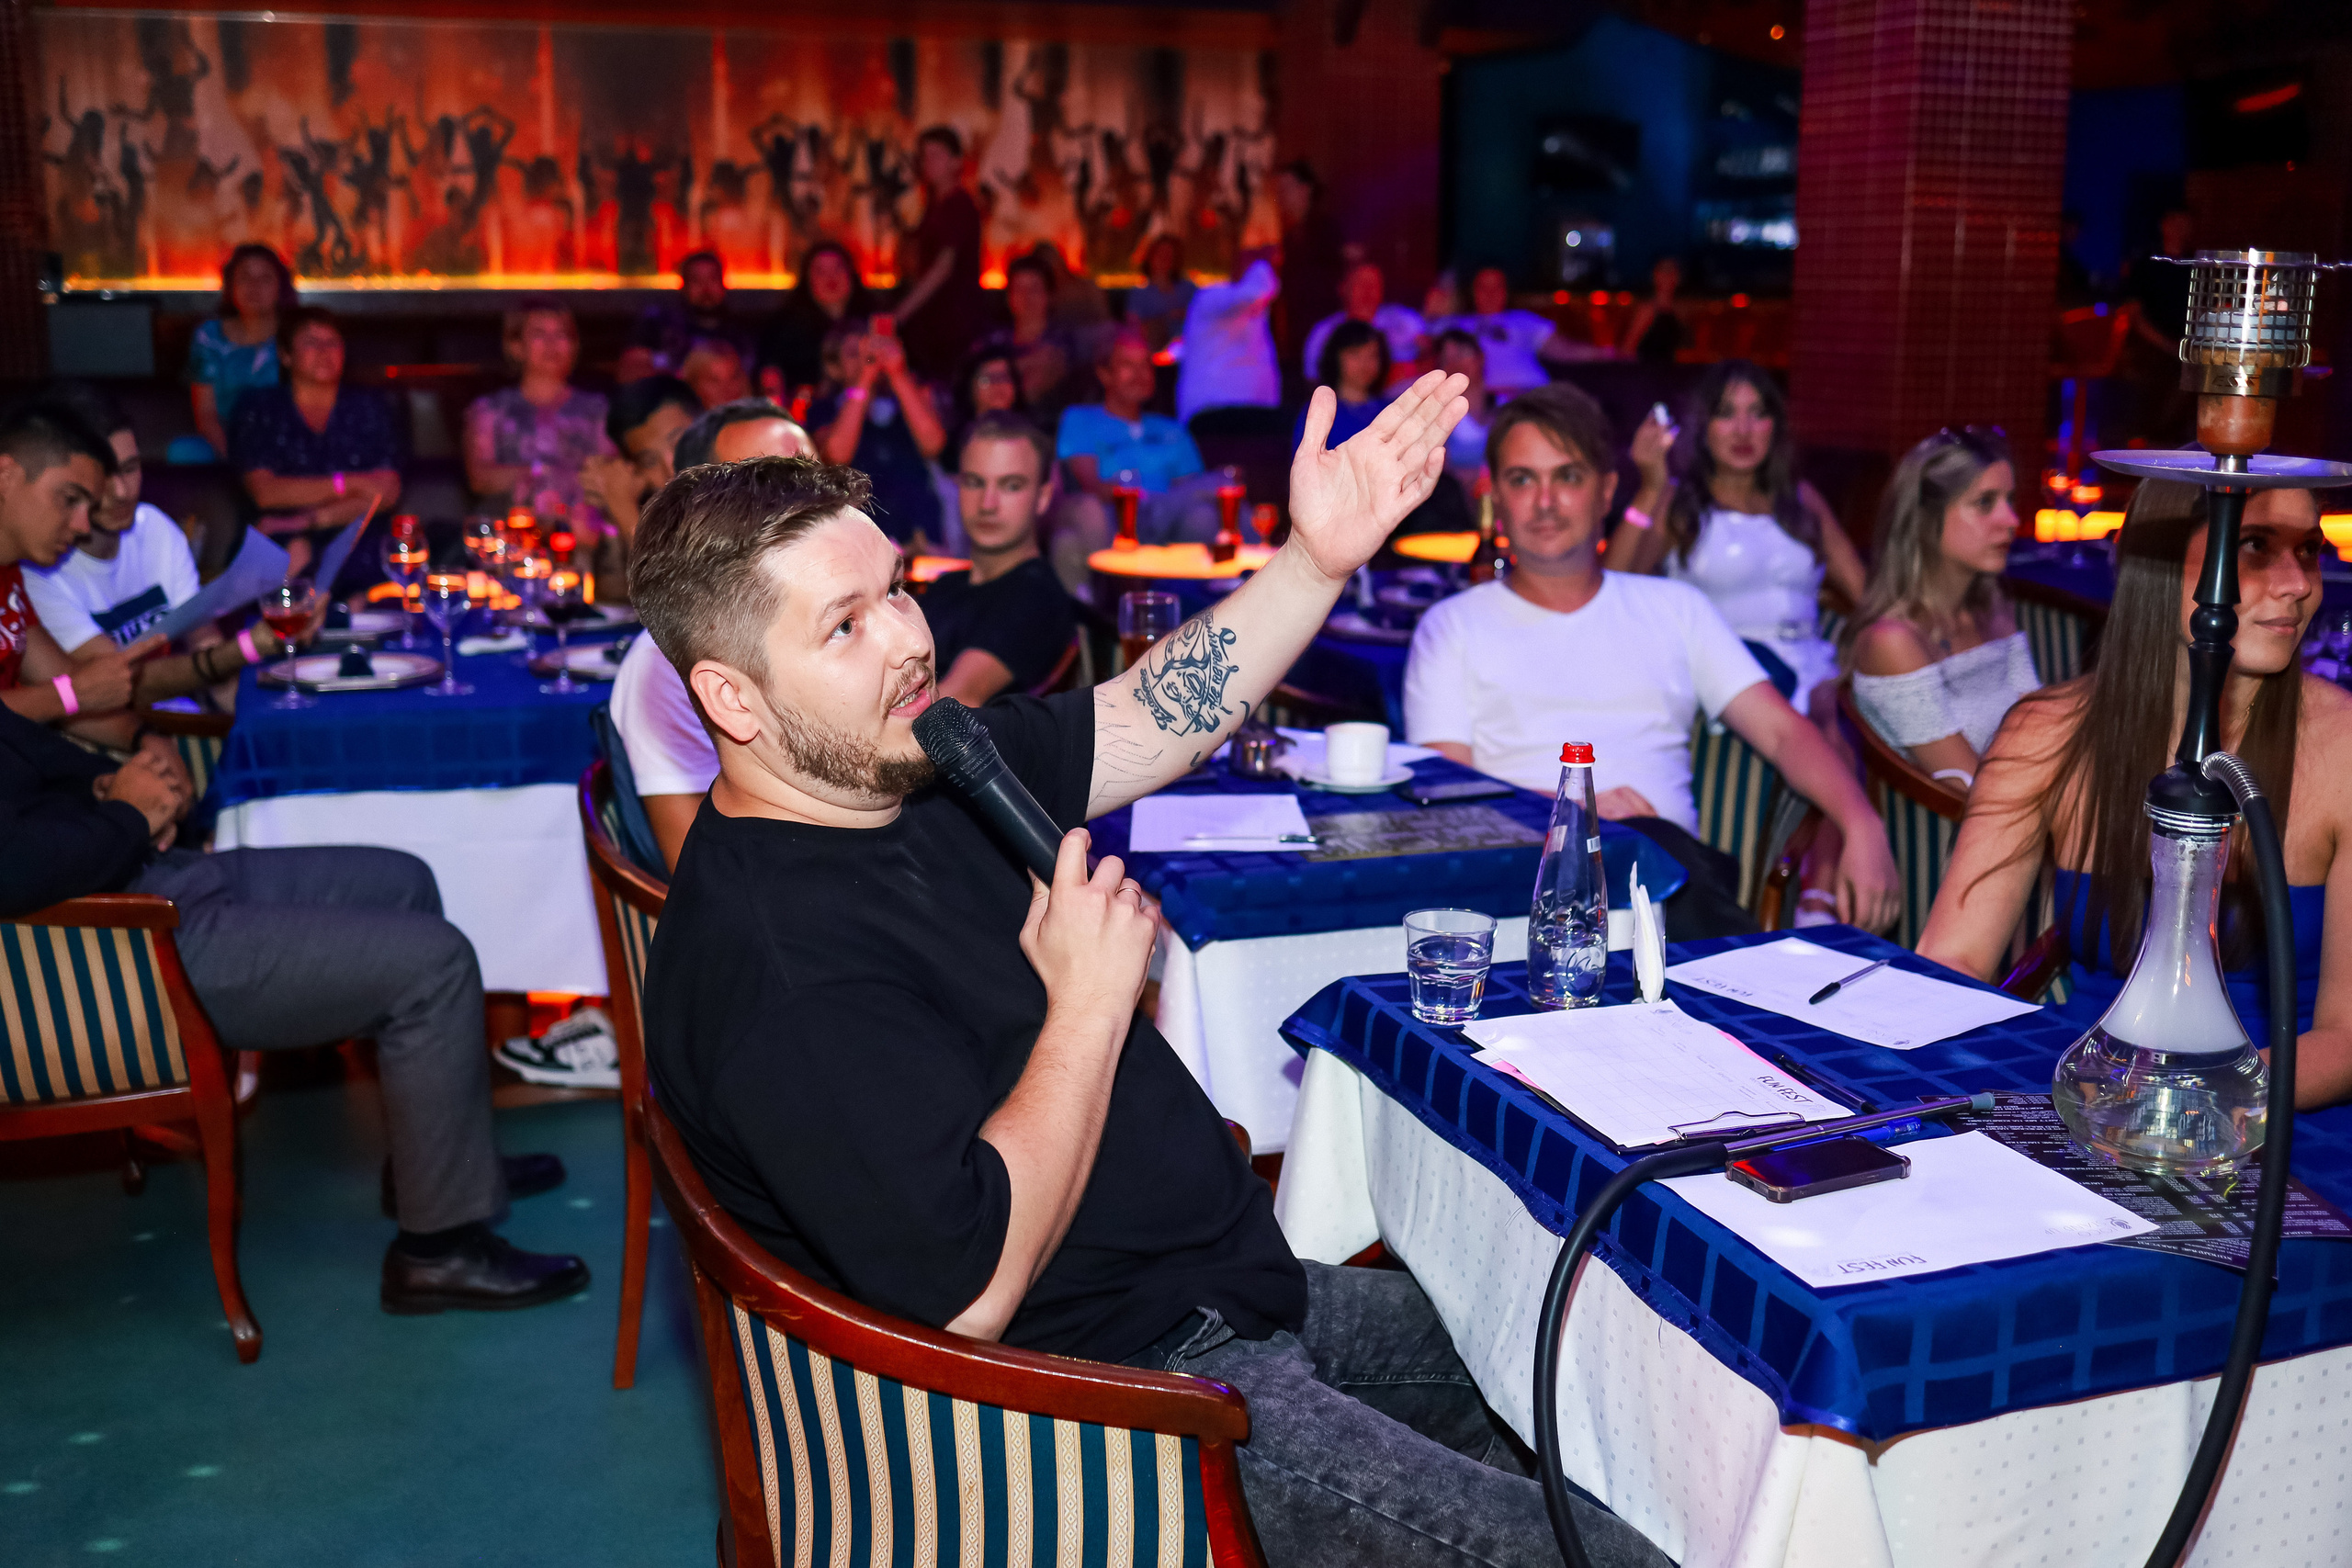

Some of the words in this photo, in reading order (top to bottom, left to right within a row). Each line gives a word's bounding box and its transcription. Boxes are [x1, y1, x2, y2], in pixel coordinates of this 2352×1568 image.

[1756, 1072, 1782, 1088] FUN
[1777, 1086, 1814, 1102] FEST
[1836, 1259, 1888, 1274] FEST
[1884, 1253, 1928, 1267] FUN
